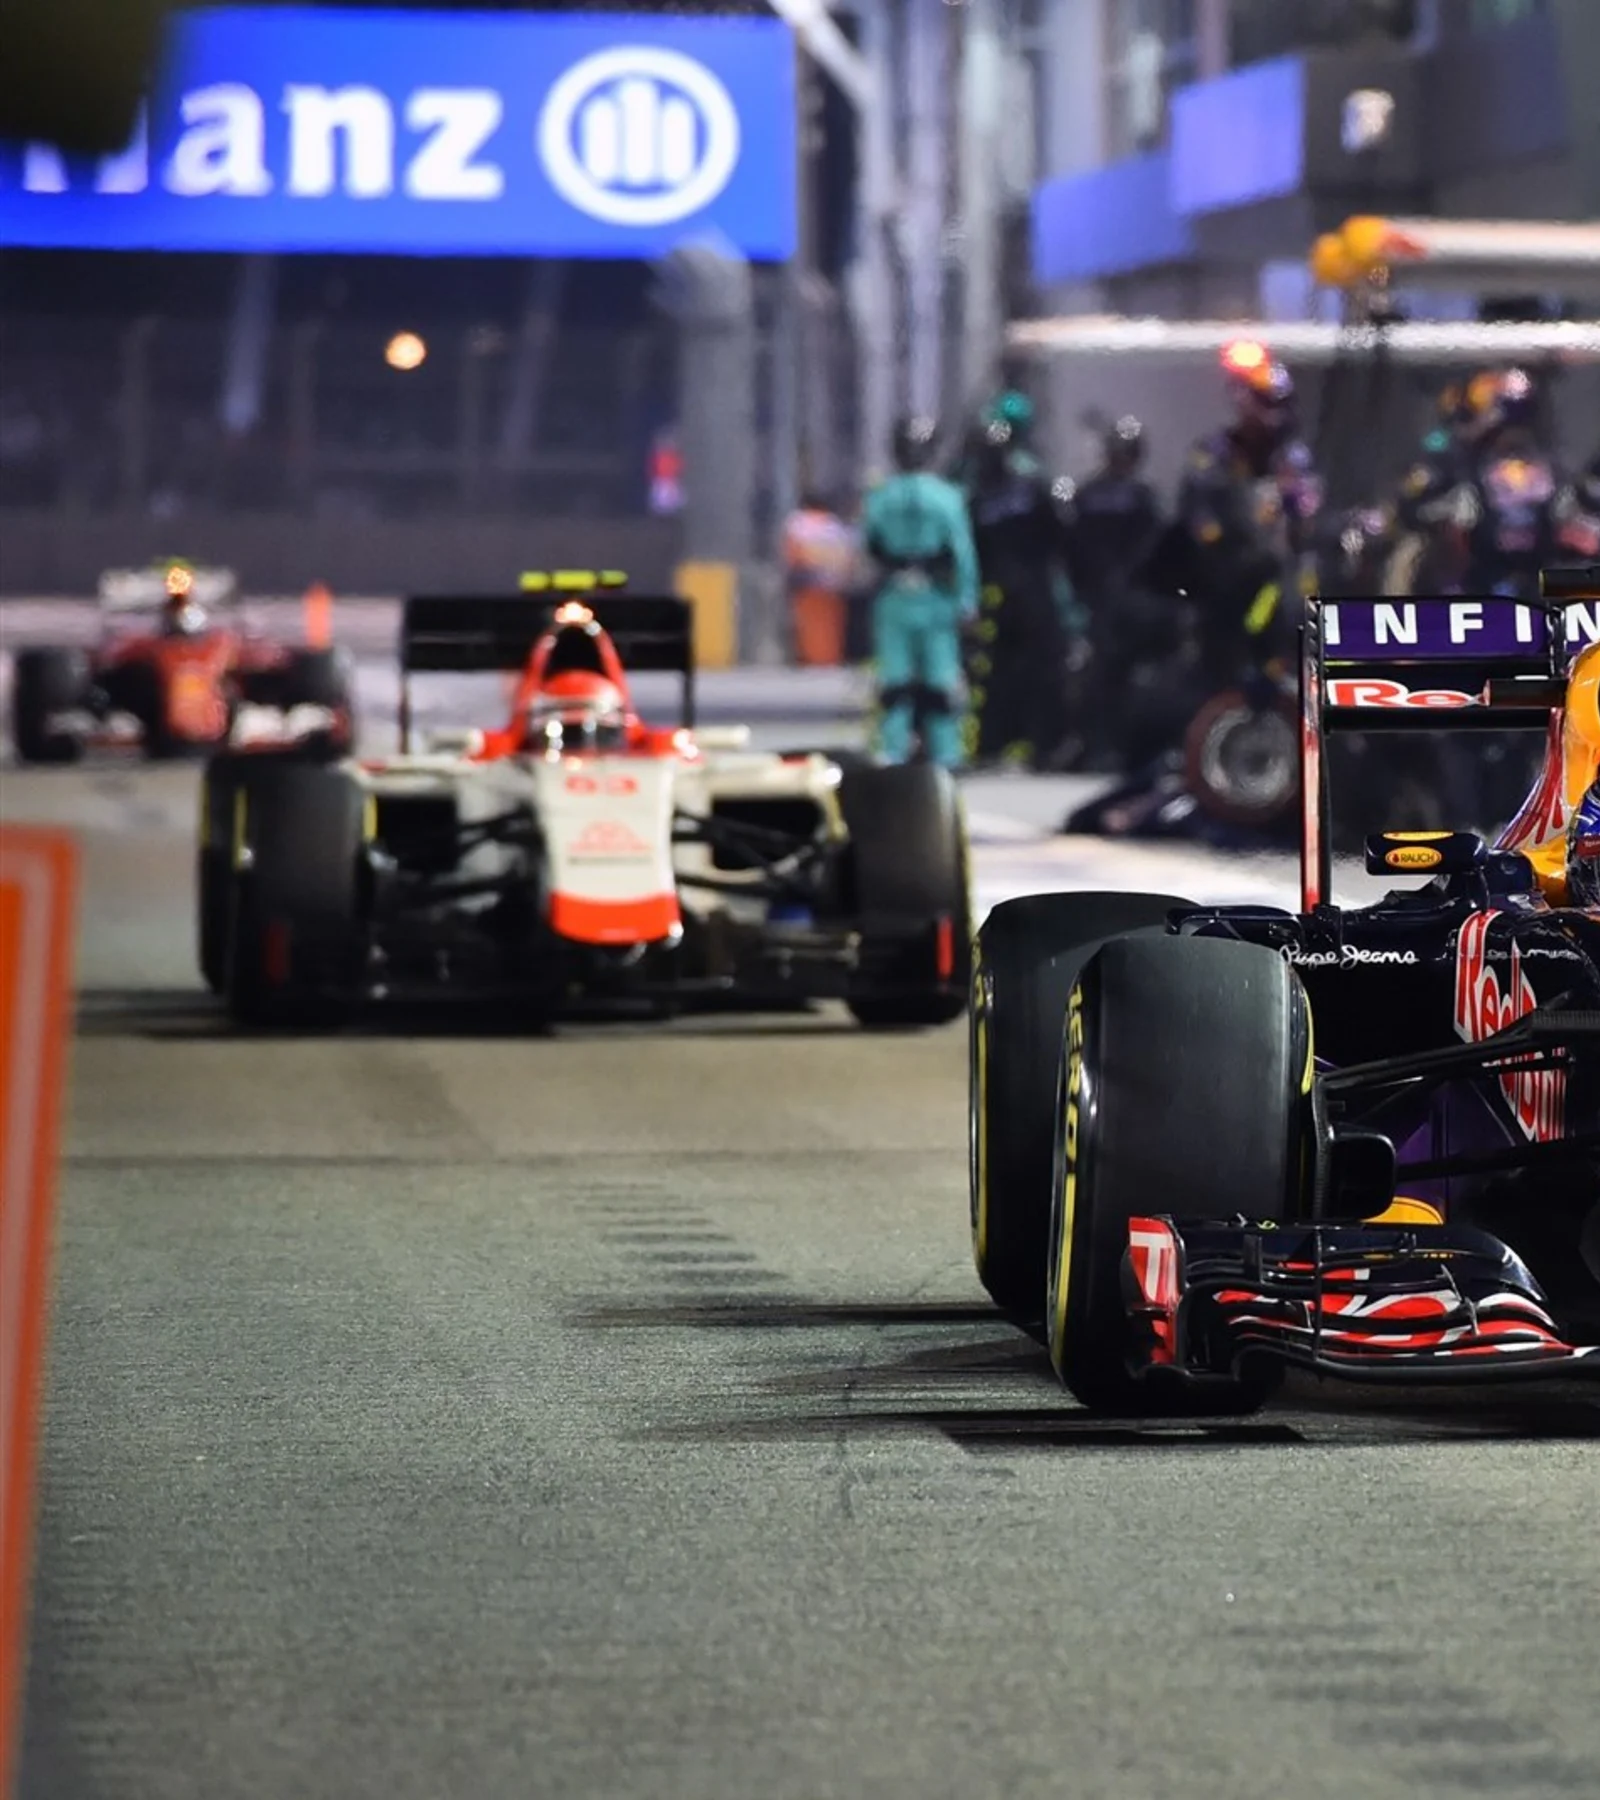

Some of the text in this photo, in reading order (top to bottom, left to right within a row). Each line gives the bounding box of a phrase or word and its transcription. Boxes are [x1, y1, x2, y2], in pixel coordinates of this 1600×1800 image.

[23, 82, 505, 199] anz
[1400, 852, 1435, 863] RAUCH
[1279, 939, 1421, 971] Pepe Jeans
